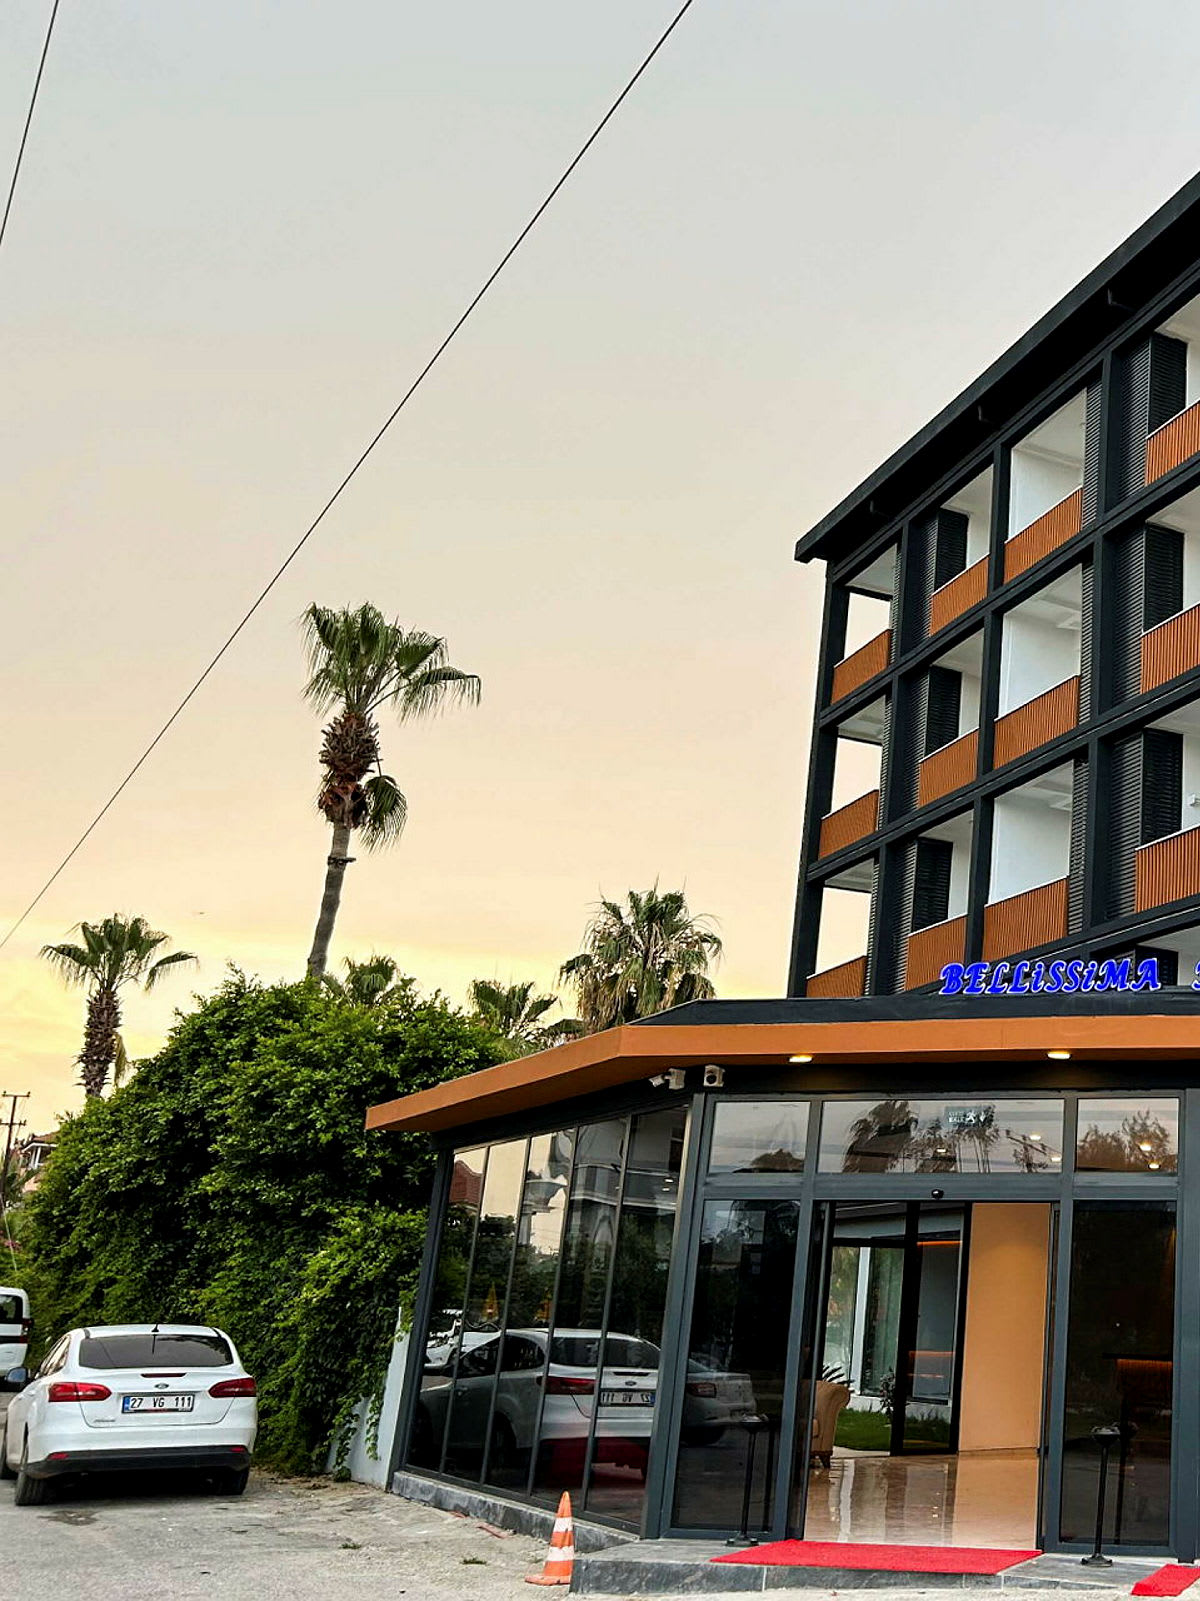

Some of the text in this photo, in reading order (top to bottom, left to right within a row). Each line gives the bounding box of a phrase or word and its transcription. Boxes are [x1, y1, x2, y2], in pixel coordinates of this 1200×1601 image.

[131, 1398, 143, 1408] 27
[153, 1398, 165, 1407] VG
[174, 1396, 191, 1407] 111
